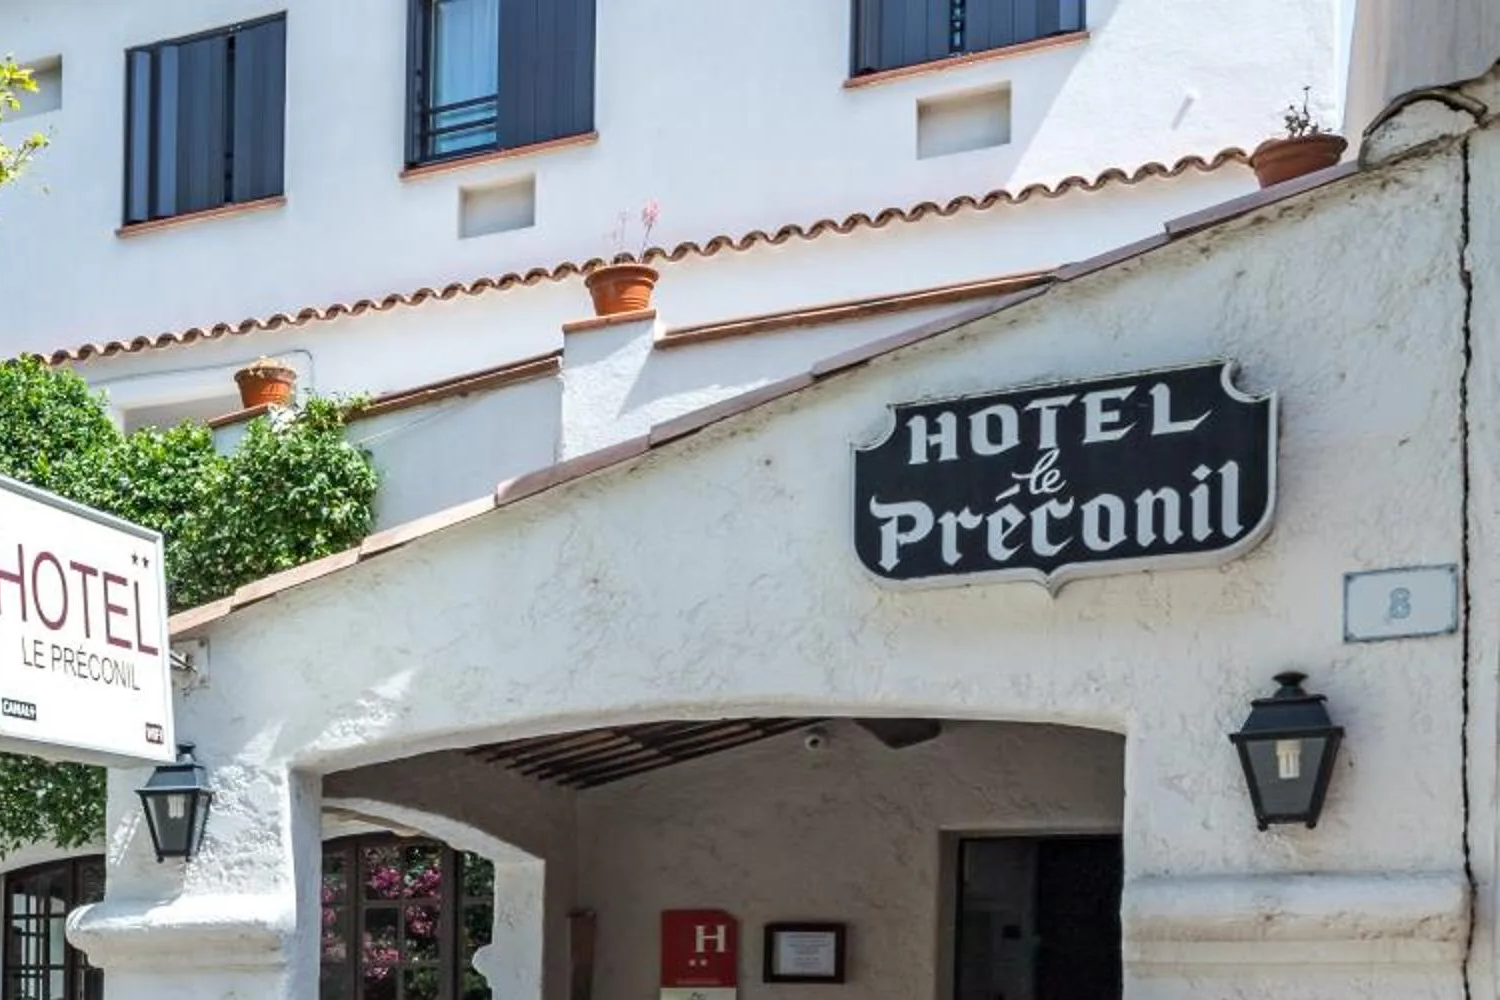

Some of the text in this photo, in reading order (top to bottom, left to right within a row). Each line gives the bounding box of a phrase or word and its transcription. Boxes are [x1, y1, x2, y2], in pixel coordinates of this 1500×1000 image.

[905, 382, 1213, 465] HOTEL
[1011, 448, 1067, 495] le
[869, 460, 1244, 573] Préconil
[1389, 586, 1412, 620] 8
[21, 635, 141, 691] LE PRÉCONIL
[693, 925, 727, 953] H
